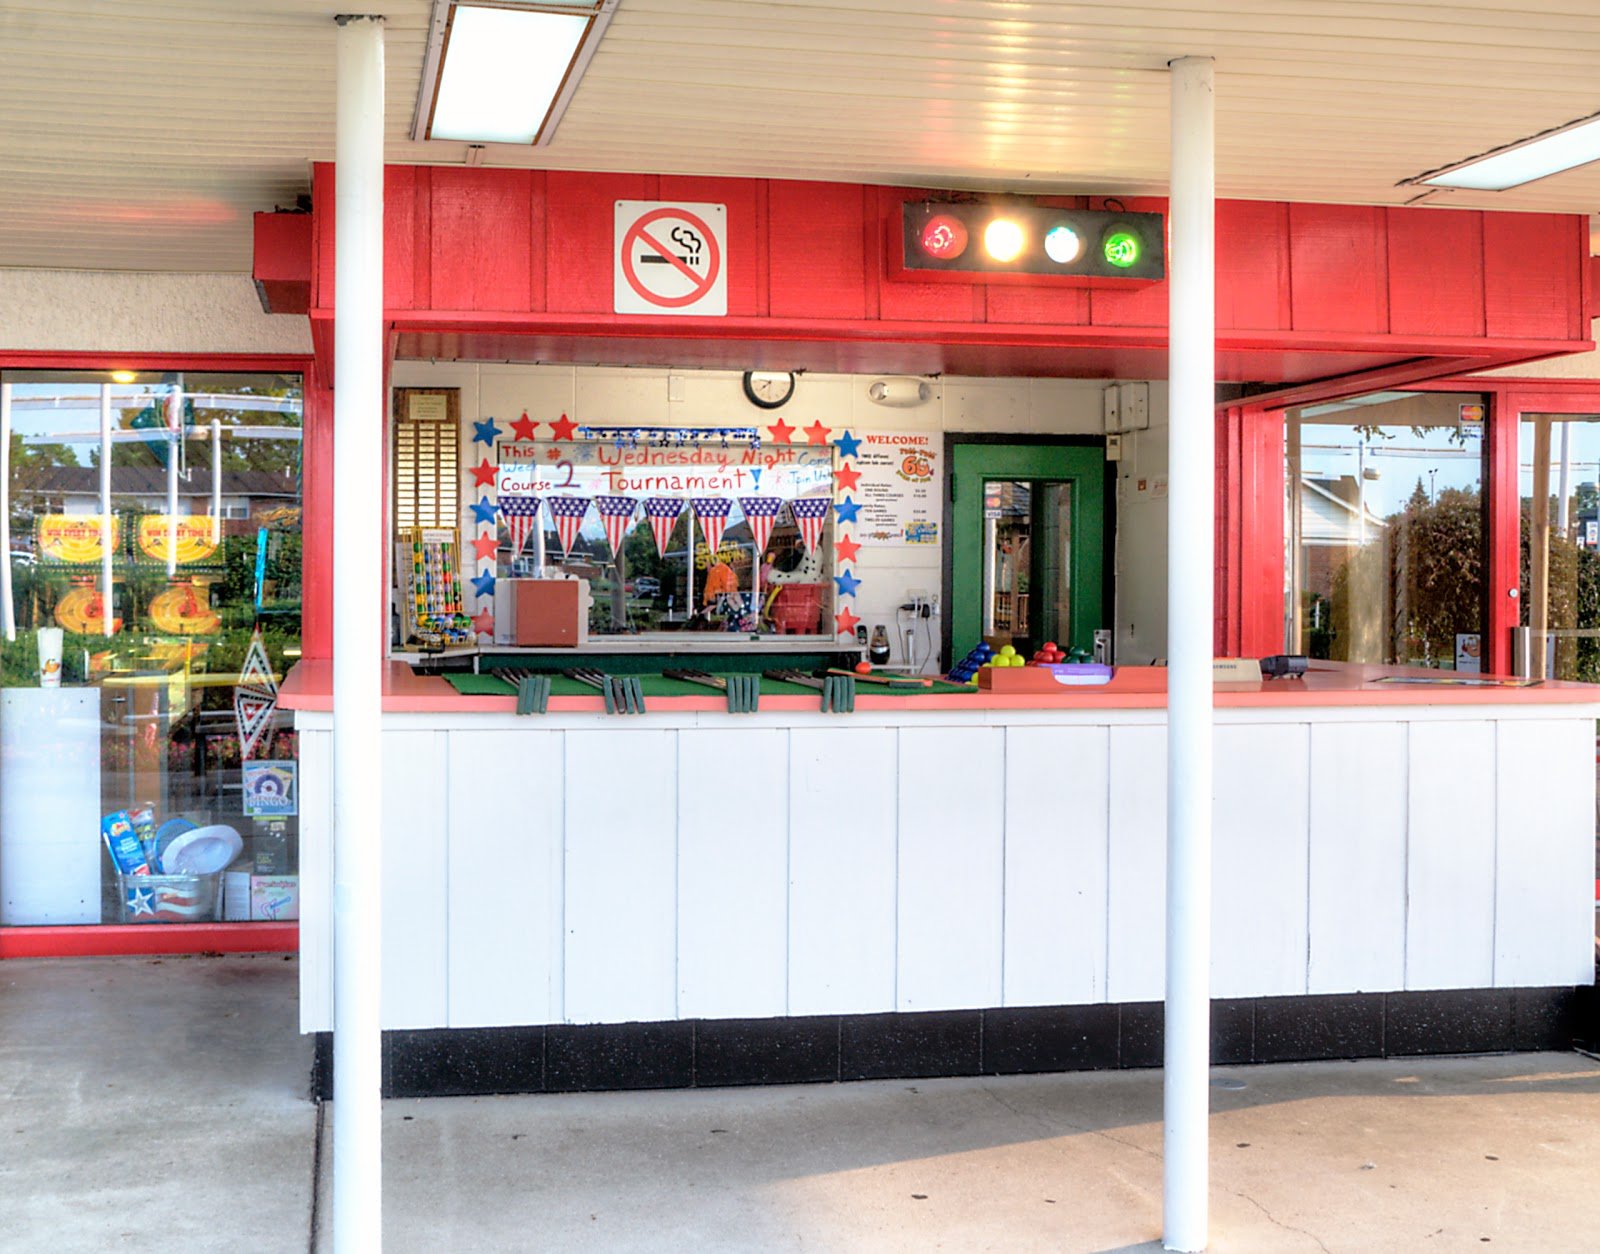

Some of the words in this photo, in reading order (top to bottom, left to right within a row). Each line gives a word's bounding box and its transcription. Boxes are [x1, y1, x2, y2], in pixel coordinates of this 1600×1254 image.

[867, 435, 929, 445] WELCOME!
[502, 445, 535, 459] This
[598, 446, 736, 473] Wednesday
[741, 447, 797, 470] Night
[553, 460, 581, 489] 2
[601, 468, 763, 491] Tournament!
[501, 477, 551, 492] Course
